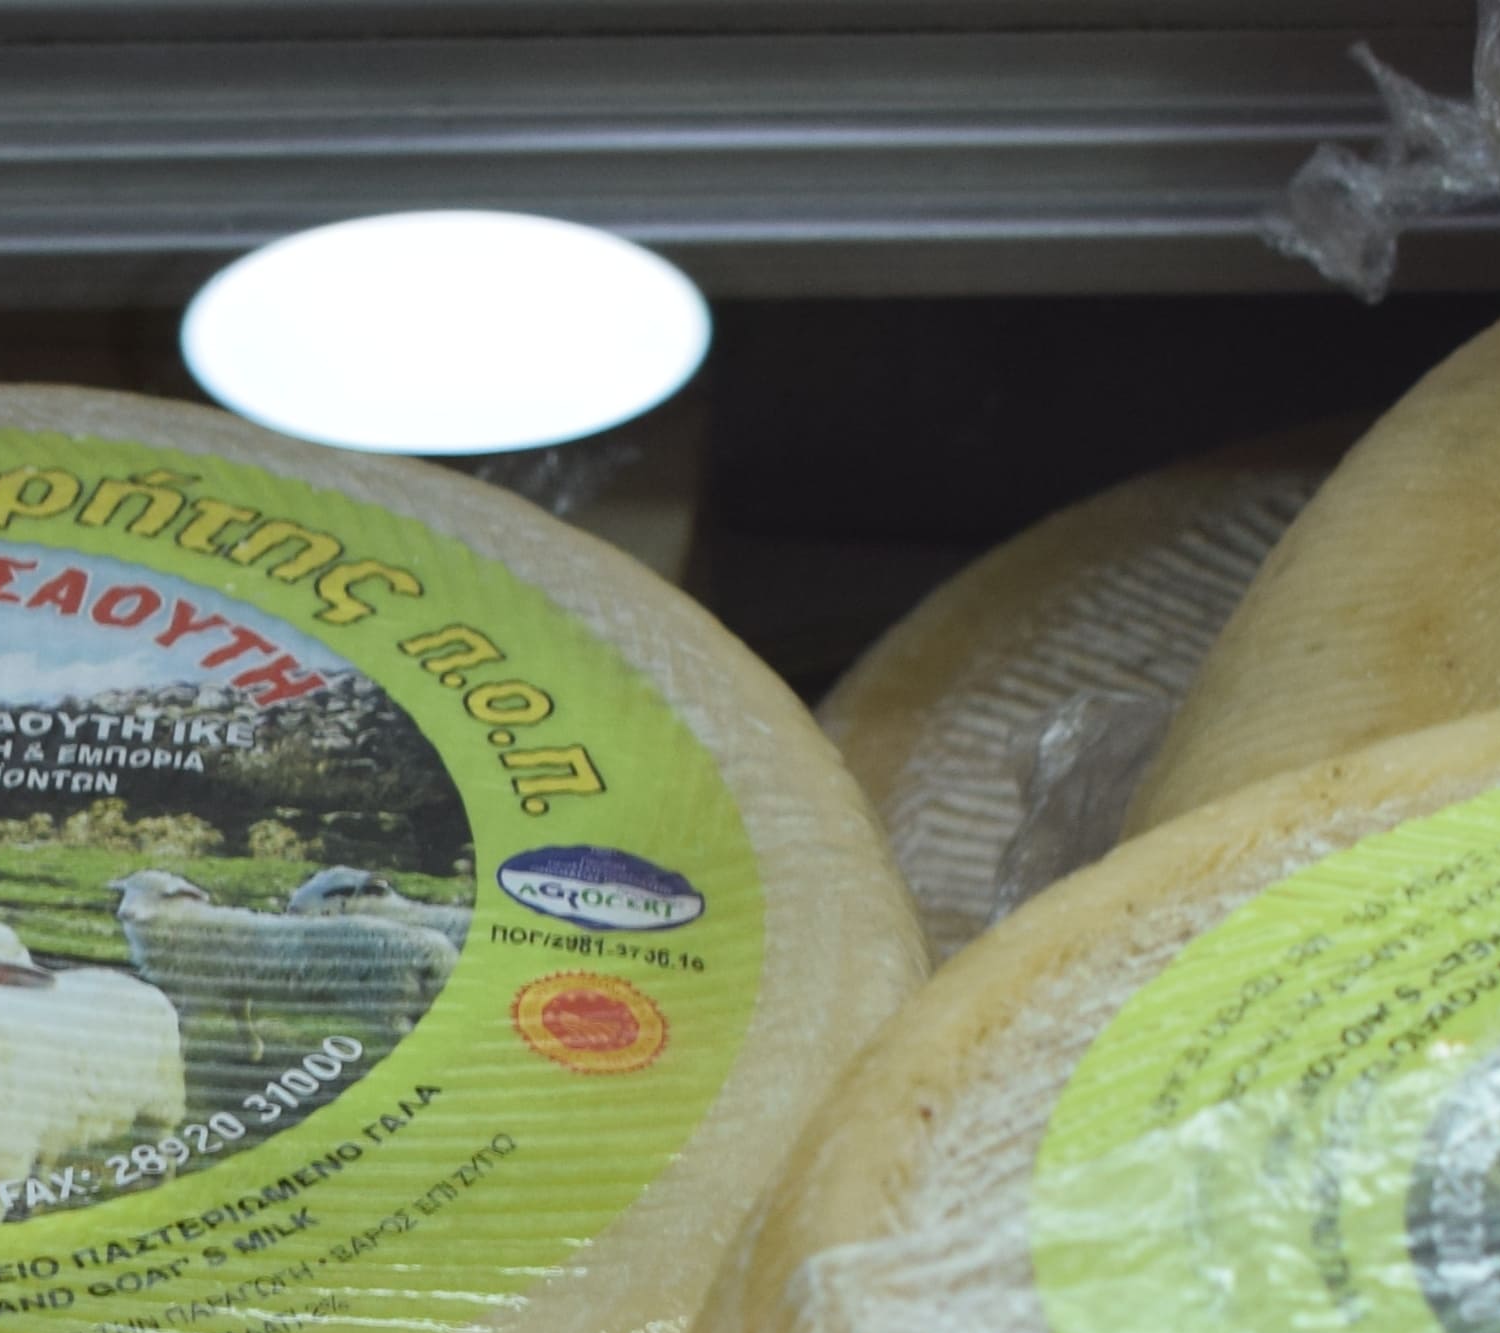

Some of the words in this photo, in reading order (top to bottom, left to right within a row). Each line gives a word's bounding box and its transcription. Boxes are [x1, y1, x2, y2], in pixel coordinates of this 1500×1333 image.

[24, 742, 45, 762] &
[57, 743, 205, 772] ΕΜΠΟΡΙΑ
[172, 717, 256, 748] ΙΚΕ
[105, 1116, 247, 1185] 28920
[243, 1035, 363, 1121] 31000
[71, 1143, 365, 1270] ΠΑΣΤΕΡΙΩΜΕΝΟ
[362, 1084, 442, 1146] ΓΑΛΑ
[233, 1205, 320, 1256] MILK
